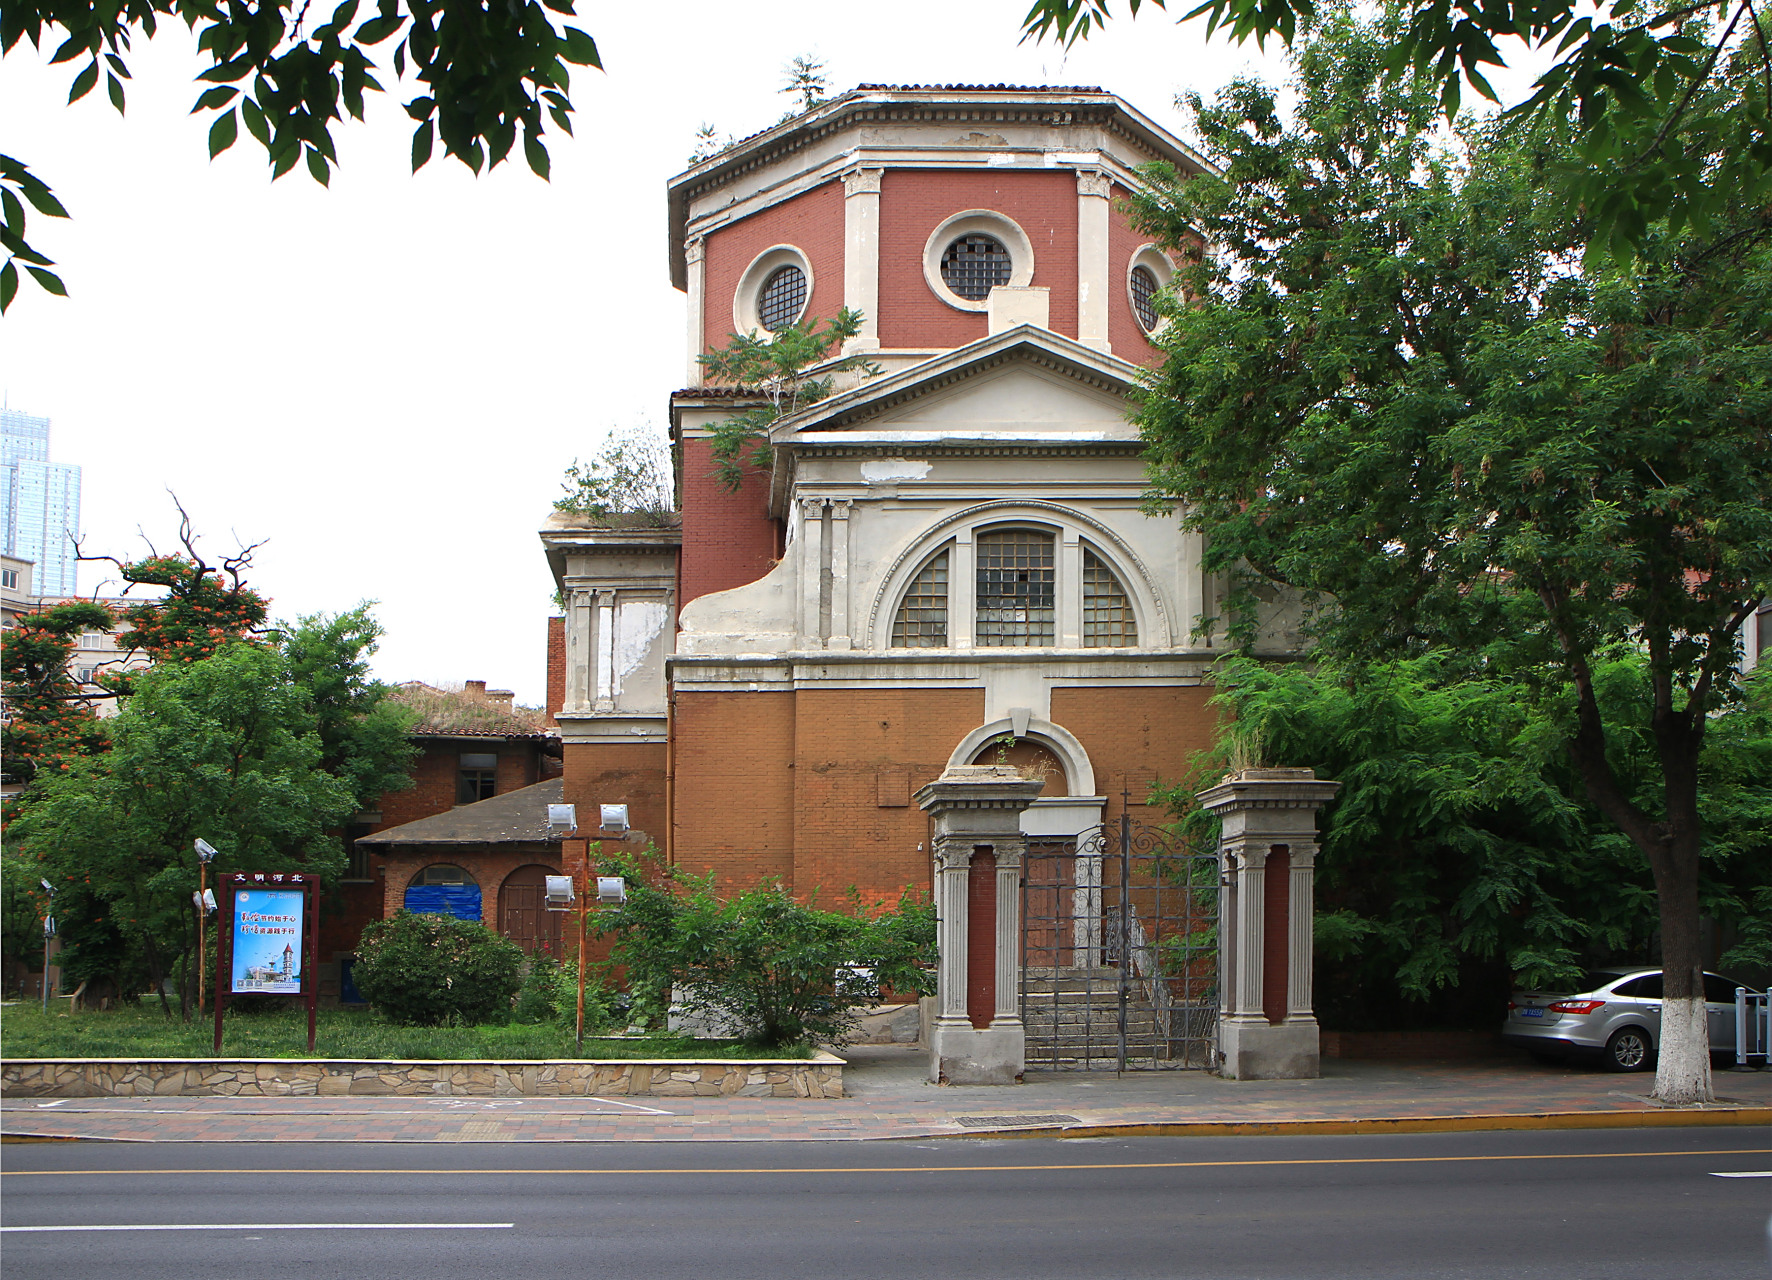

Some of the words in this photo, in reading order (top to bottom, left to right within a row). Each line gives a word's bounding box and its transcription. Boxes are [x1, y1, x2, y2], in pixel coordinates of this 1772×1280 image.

[235, 873, 303, 882] 文明河北
[241, 912, 296, 922] 勤俭节约始于心
[241, 924, 295, 934] 珍惜资源践于行
